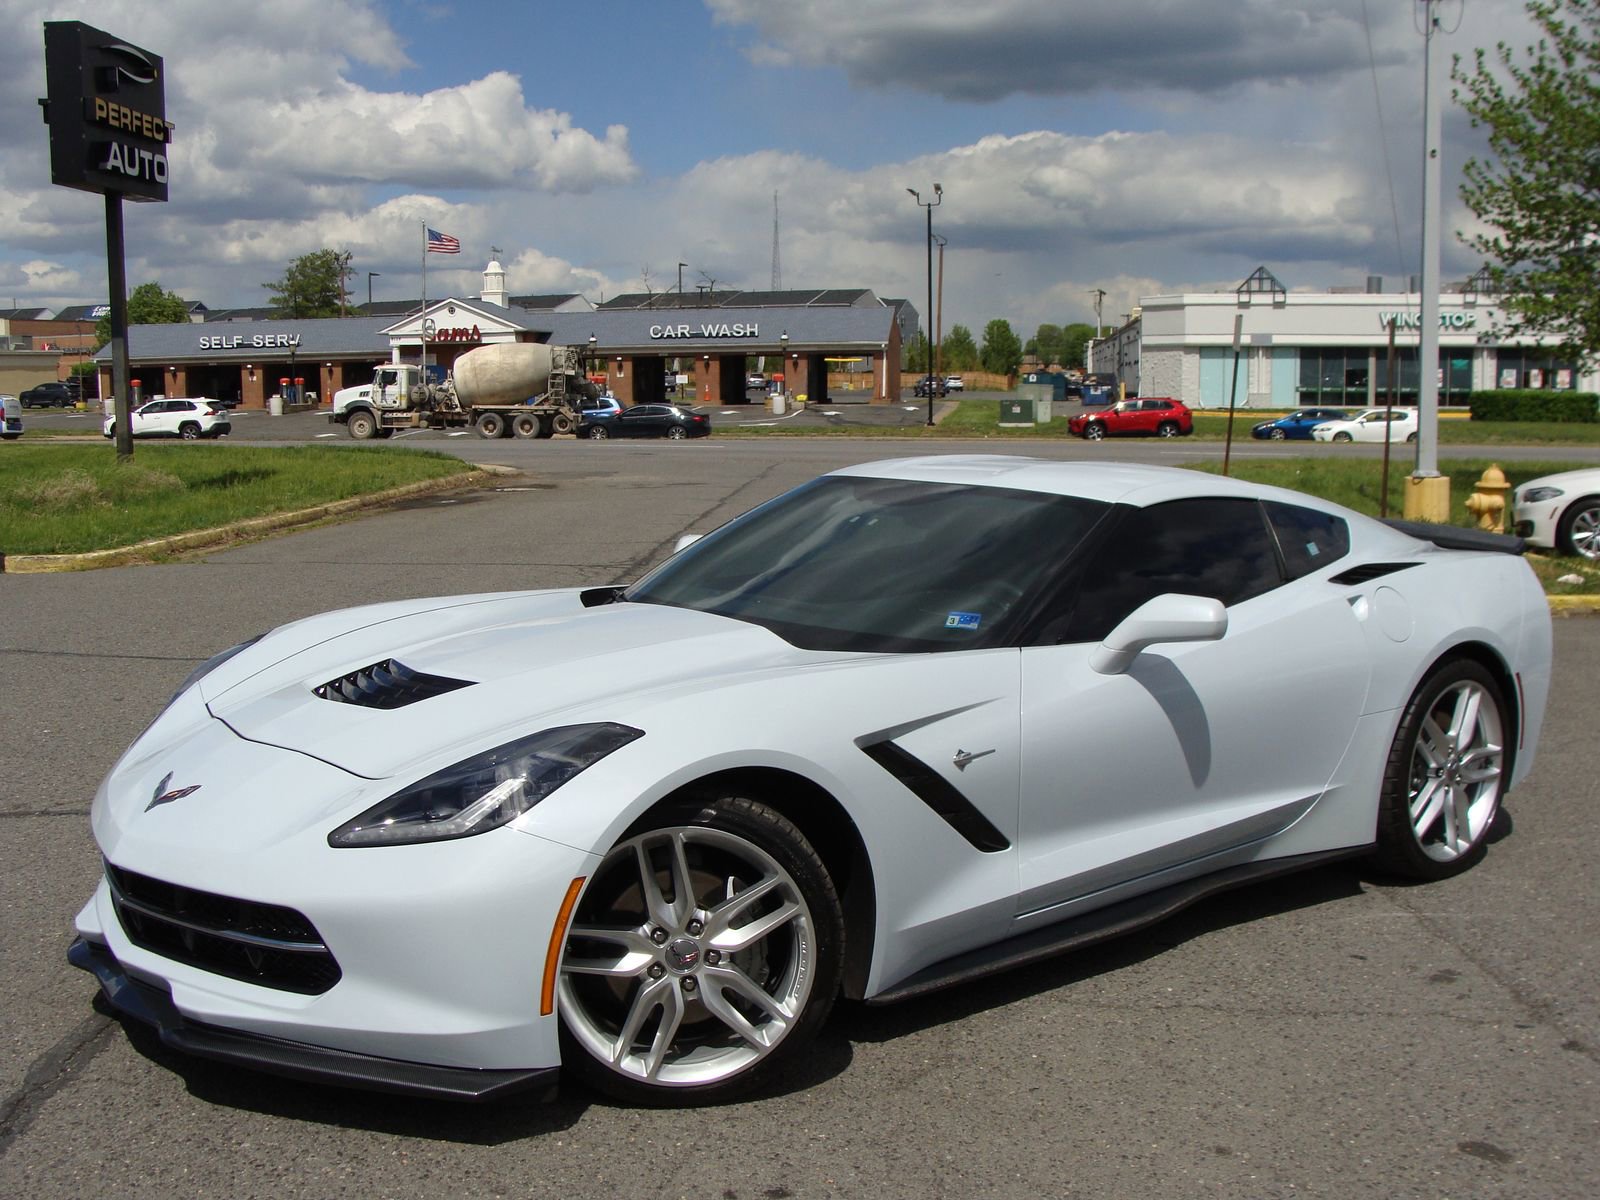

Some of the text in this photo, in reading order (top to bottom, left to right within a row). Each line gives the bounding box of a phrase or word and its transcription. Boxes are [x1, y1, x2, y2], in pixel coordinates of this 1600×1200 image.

[95, 97, 175, 144] PERFECT
[106, 141, 169, 184] AUTO
[1379, 312, 1477, 328] WINTOP
[649, 323, 759, 339] CAR WASH
[199, 333, 301, 349] SELF SERV
